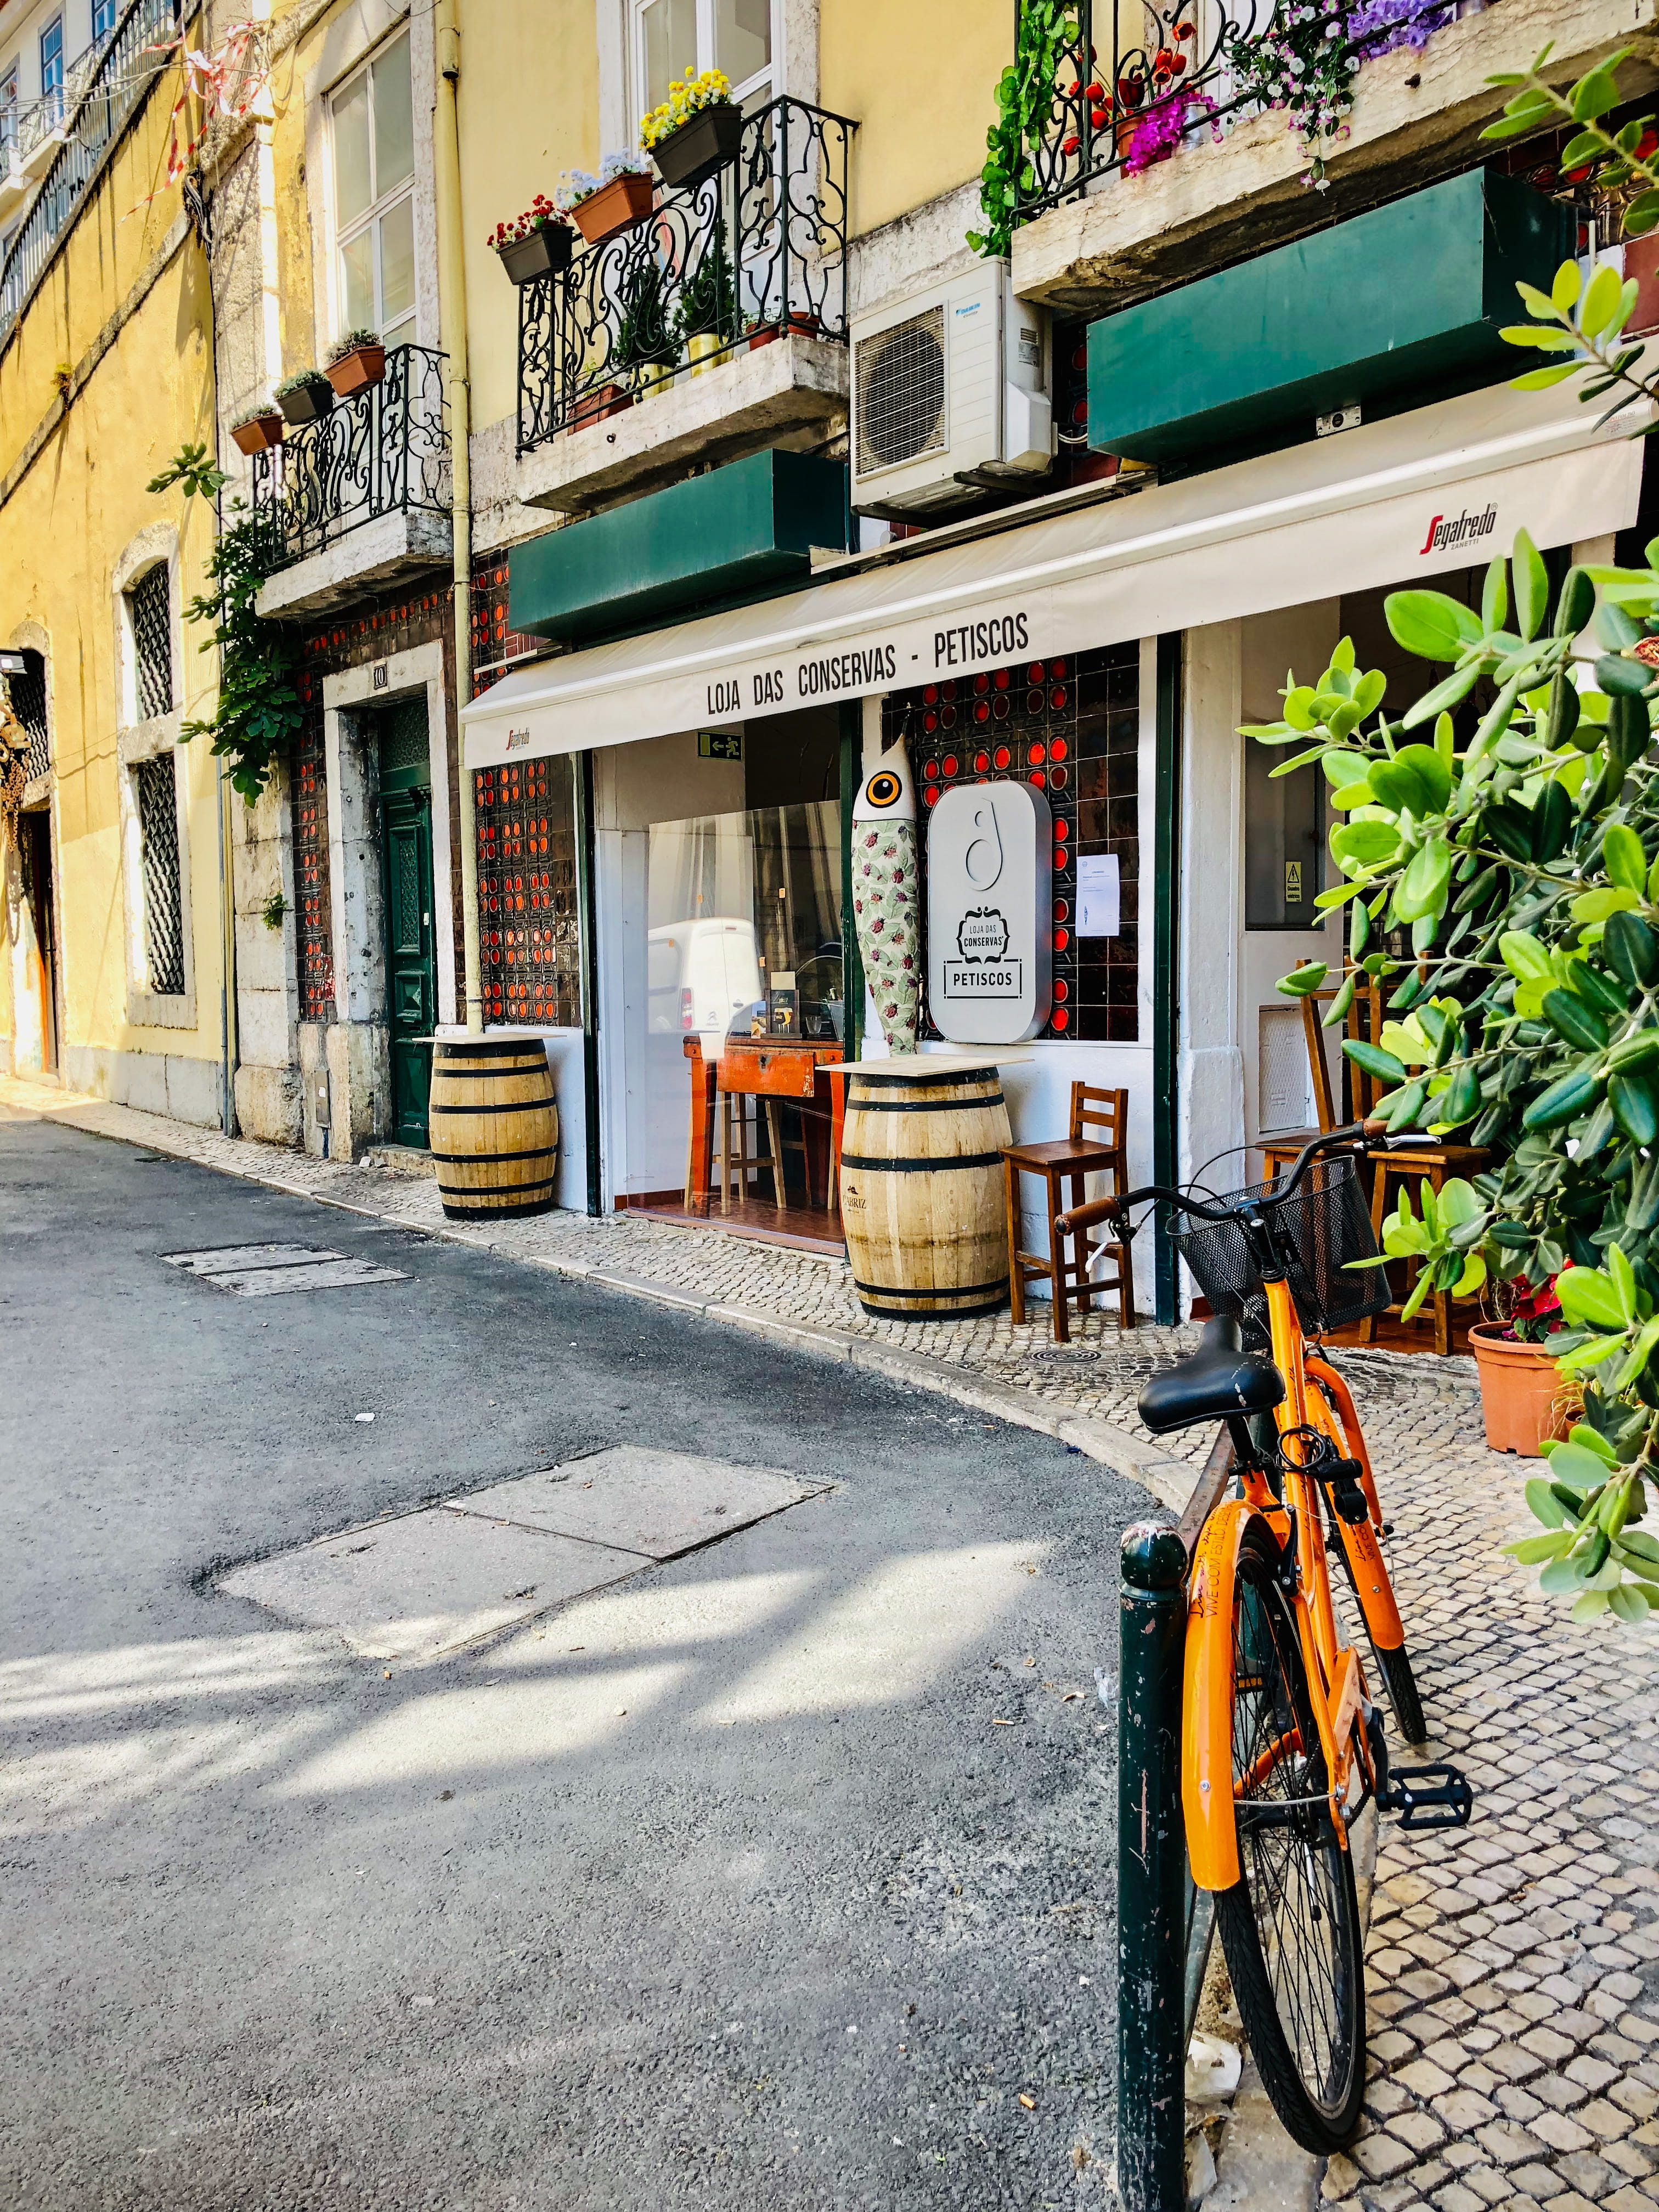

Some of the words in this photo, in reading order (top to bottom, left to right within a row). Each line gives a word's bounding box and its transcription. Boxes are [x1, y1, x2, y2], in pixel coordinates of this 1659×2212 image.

[1419, 503, 1497, 555] Segafredo
[1451, 538, 1480, 550] ZANETTI
[708, 680, 741, 715] LOJA
[754, 670, 783, 706] DAS
[798, 644, 896, 697] CONSERVAS
[934, 612, 1029, 668] PETISCOS
[375, 668, 383, 686] 10
[969, 926, 984, 934] LOJA
[985, 925, 996, 933] DAS
[964, 936, 1003, 947] CONSERVAS
[953, 972, 1012, 986] PETISCOS
[1364, 1542, 1375, 1560] VIVE
[1207, 1558, 1221, 1586] COM
[1206, 1590, 1218, 1618] VIVE
